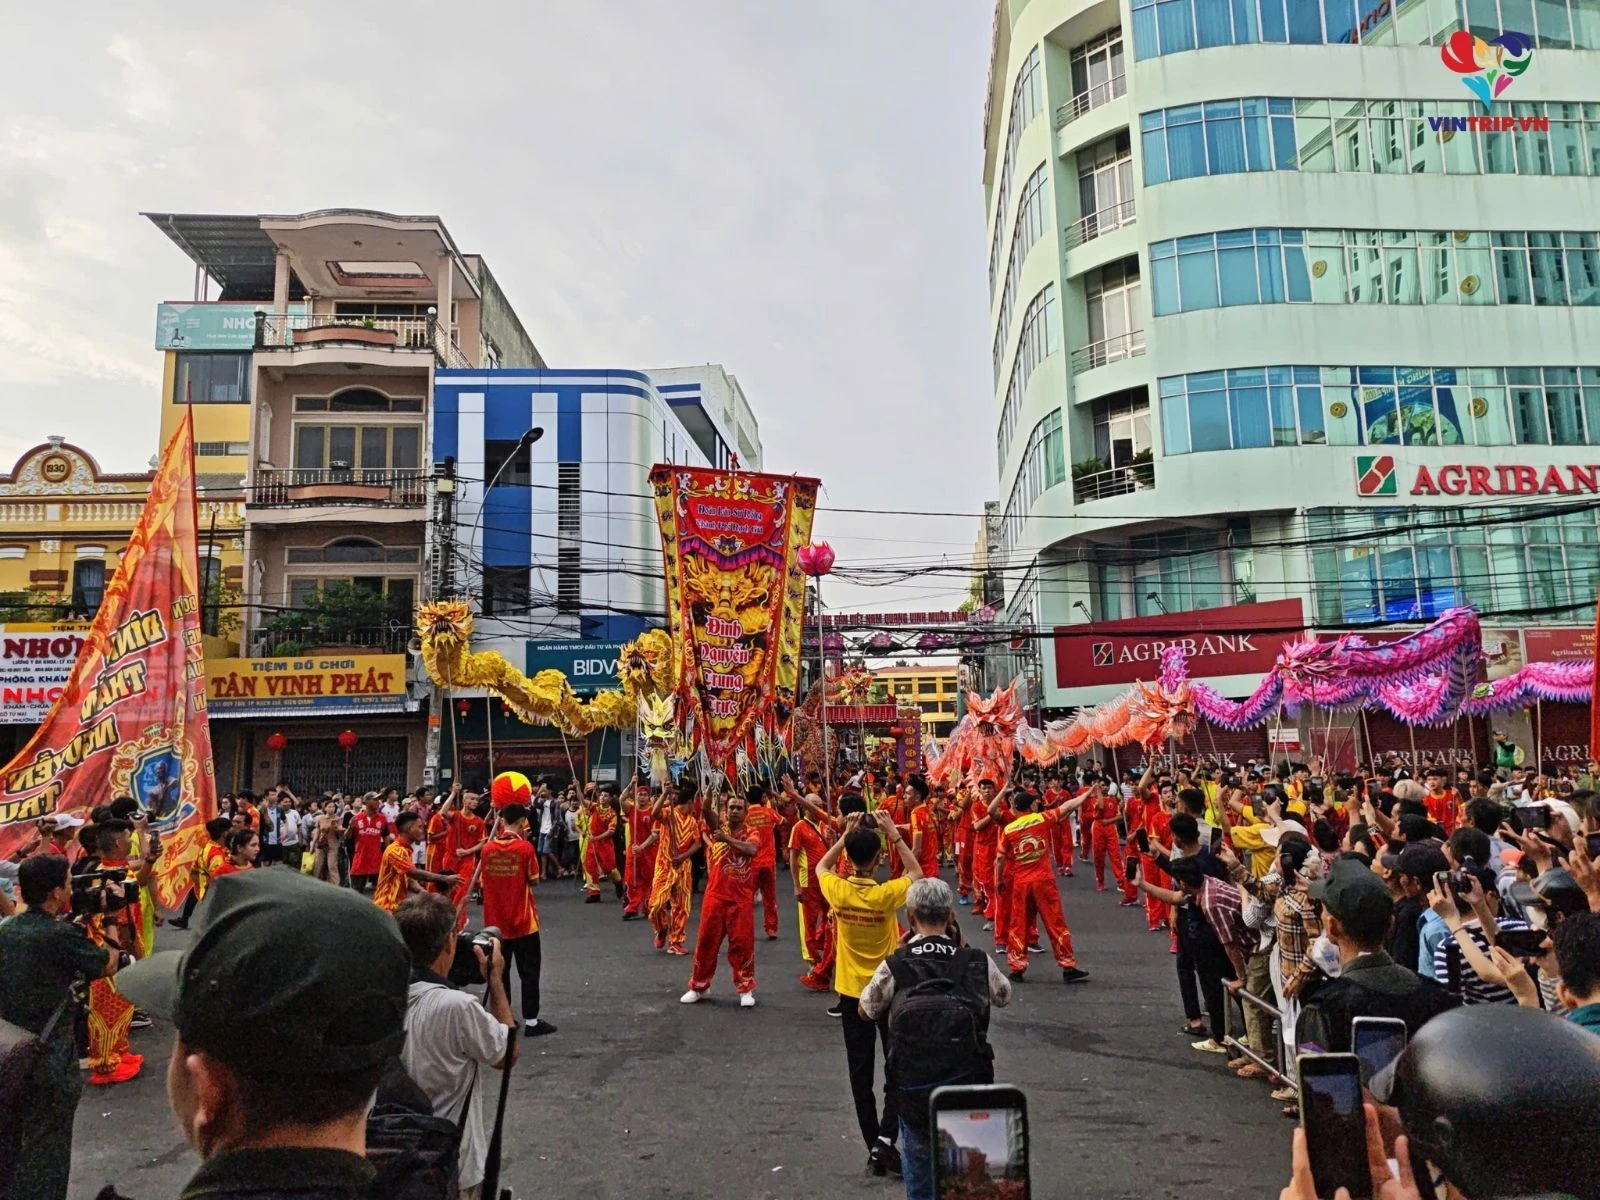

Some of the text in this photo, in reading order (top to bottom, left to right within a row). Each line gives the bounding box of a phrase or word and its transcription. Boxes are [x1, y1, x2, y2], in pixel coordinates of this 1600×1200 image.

[1410, 465, 1600, 495] AGRIBAN
[705, 615, 742, 639] Đình
[251, 659, 355, 672] TIỆM ĐỒ CHƠI
[699, 641, 750, 667] Nguyễn
[574, 659, 617, 676] BIDV
[211, 666, 394, 698] TÂN VINH PHÁT
[702, 668, 744, 693] Trung
[1542, 745, 1592, 761] AGRI
[911, 942, 957, 956] SONY
